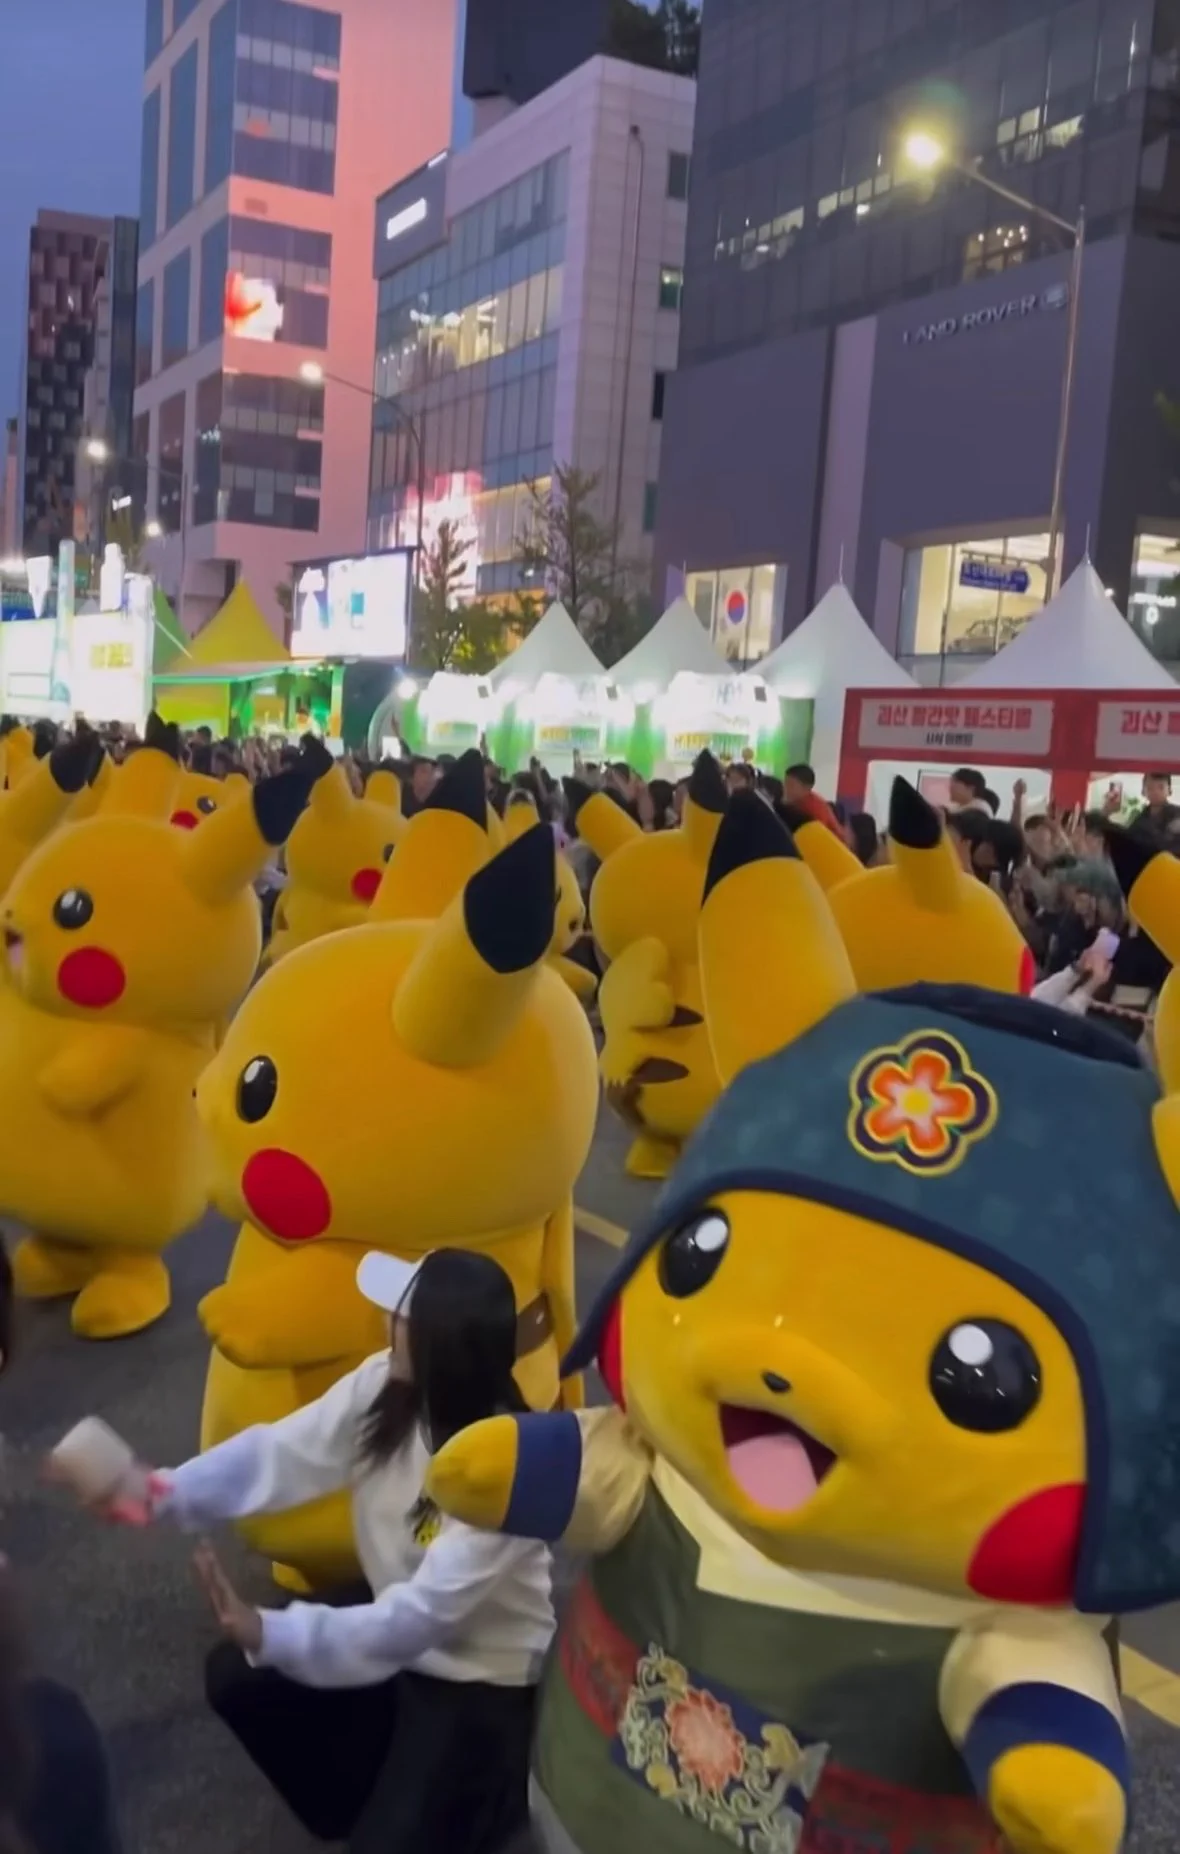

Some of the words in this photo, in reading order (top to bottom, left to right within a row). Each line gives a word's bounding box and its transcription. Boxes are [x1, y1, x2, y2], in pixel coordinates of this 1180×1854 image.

[903, 319, 957, 344] LAND
[963, 294, 1036, 329] ROVER
[911, 705, 960, 727] 간맛
[963, 706, 1032, 729] 페스티
